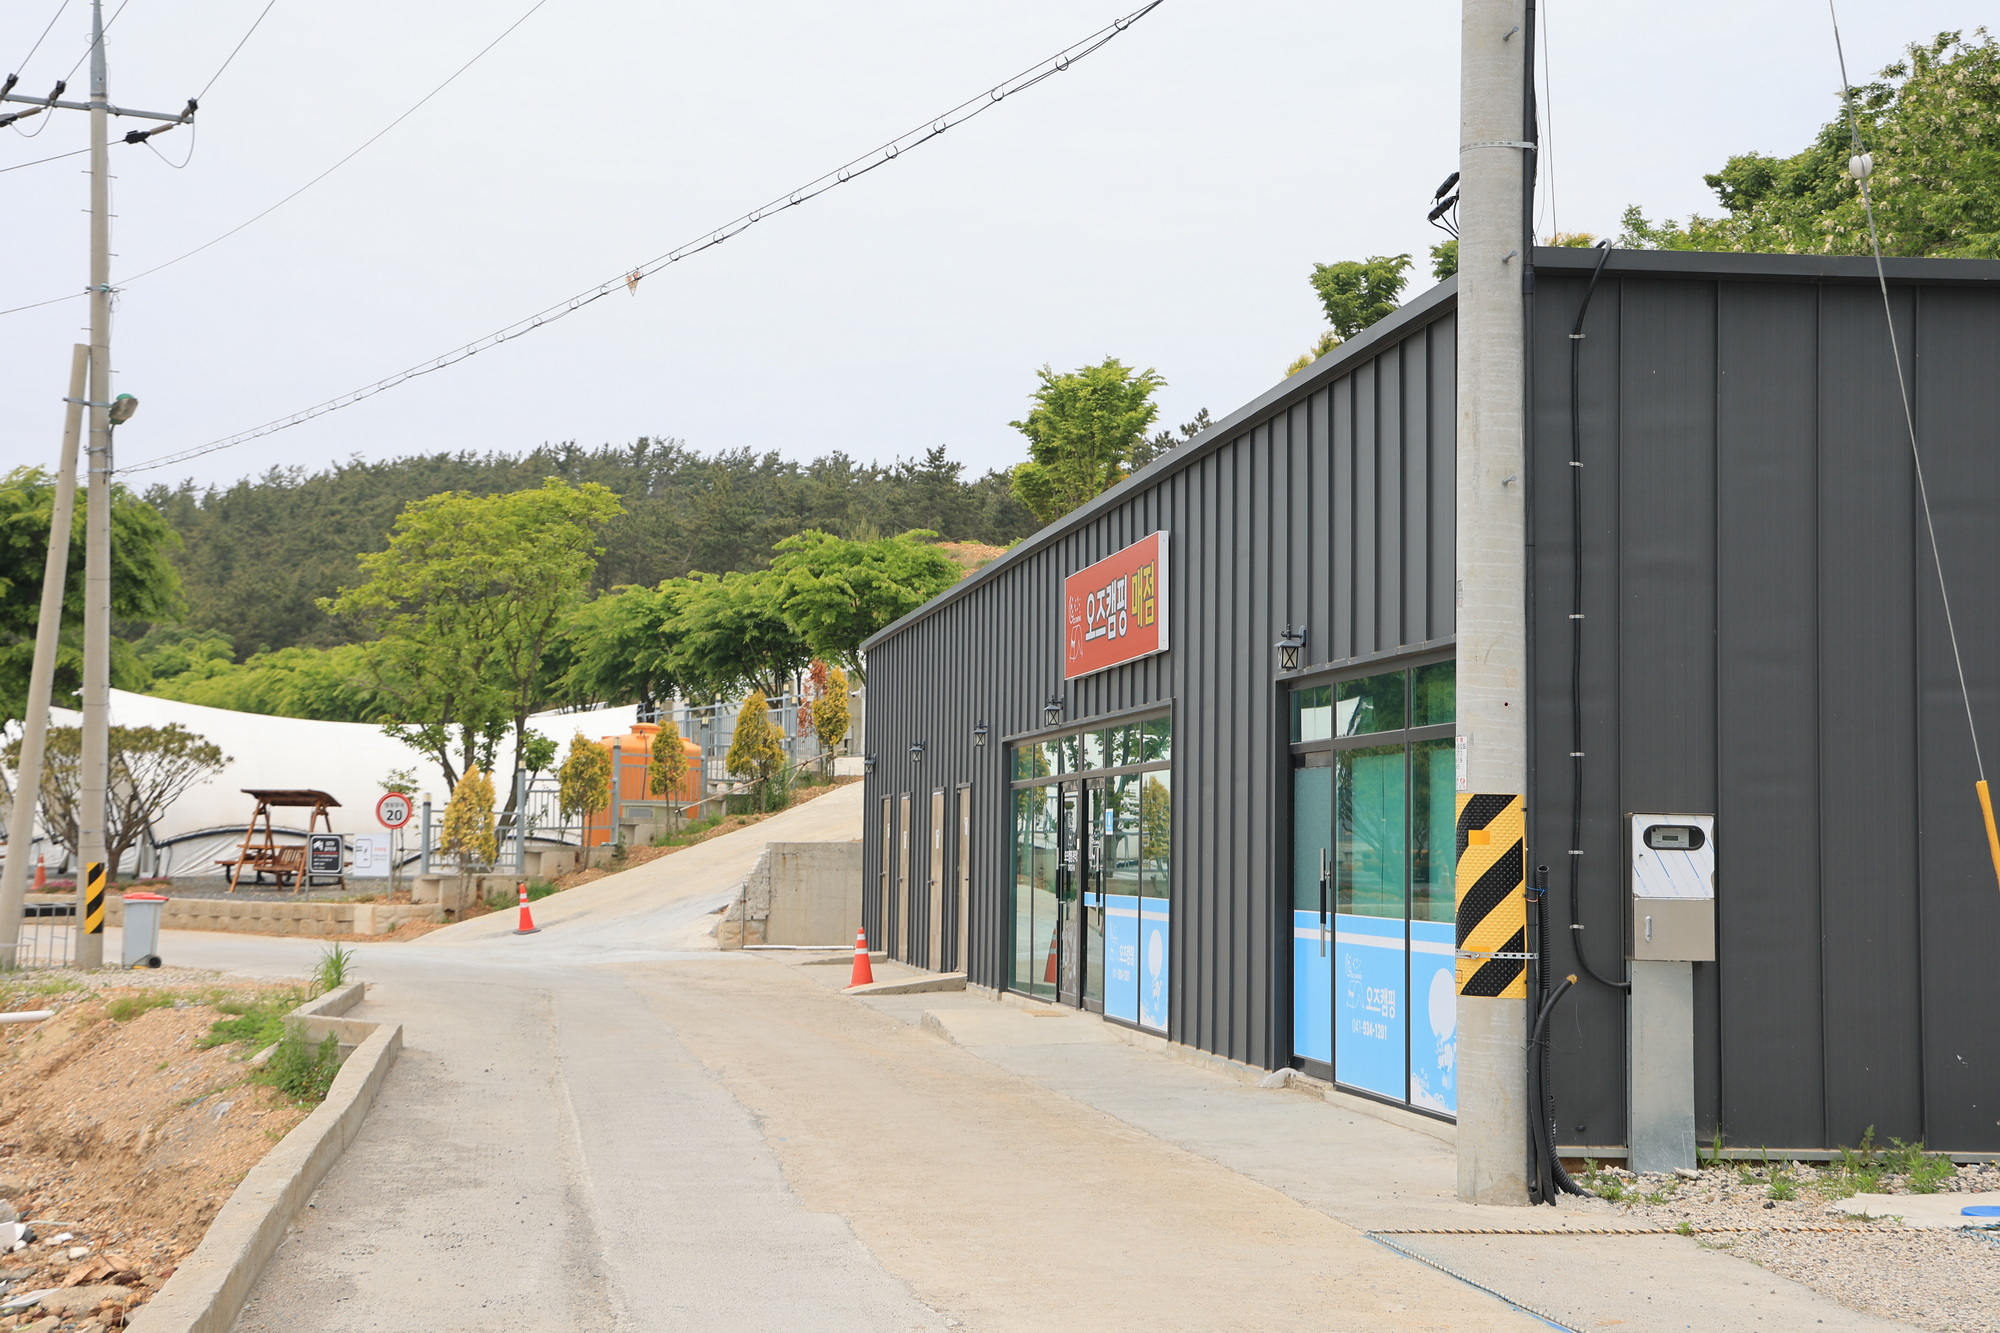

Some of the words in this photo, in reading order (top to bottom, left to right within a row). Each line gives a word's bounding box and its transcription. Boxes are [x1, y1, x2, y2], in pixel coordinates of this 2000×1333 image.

[1085, 573, 1127, 641] 오즈캠핑
[1131, 560, 1155, 628] 매점
[387, 810, 403, 821] 20
